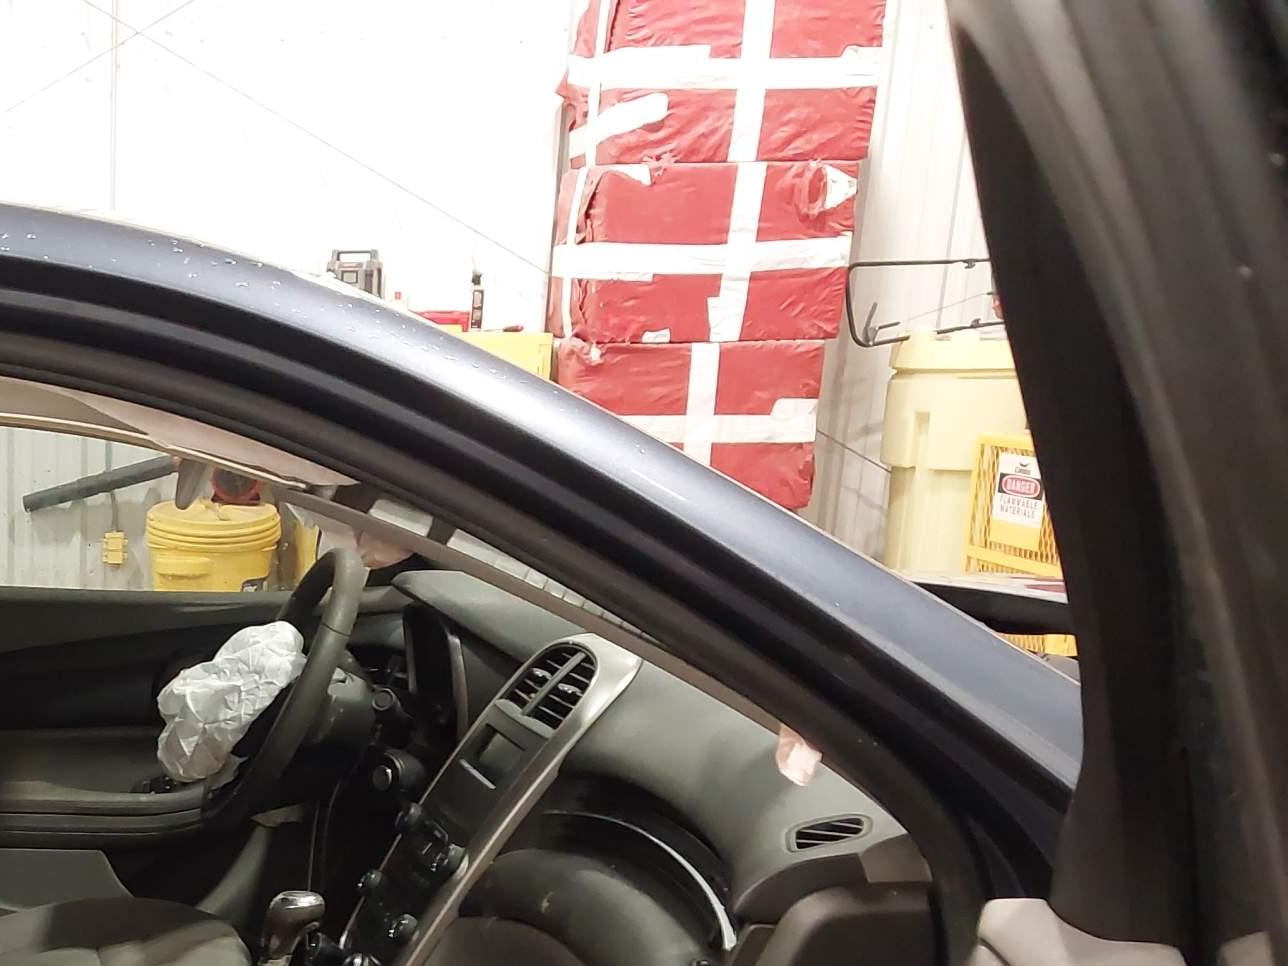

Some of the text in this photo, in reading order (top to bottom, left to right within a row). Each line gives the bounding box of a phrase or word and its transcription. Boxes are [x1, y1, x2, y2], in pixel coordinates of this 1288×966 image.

[1006, 478, 1036, 494] DANGER
[999, 494, 1038, 508] FLAMMABLE
[1000, 503, 1035, 518] MATERIALS
